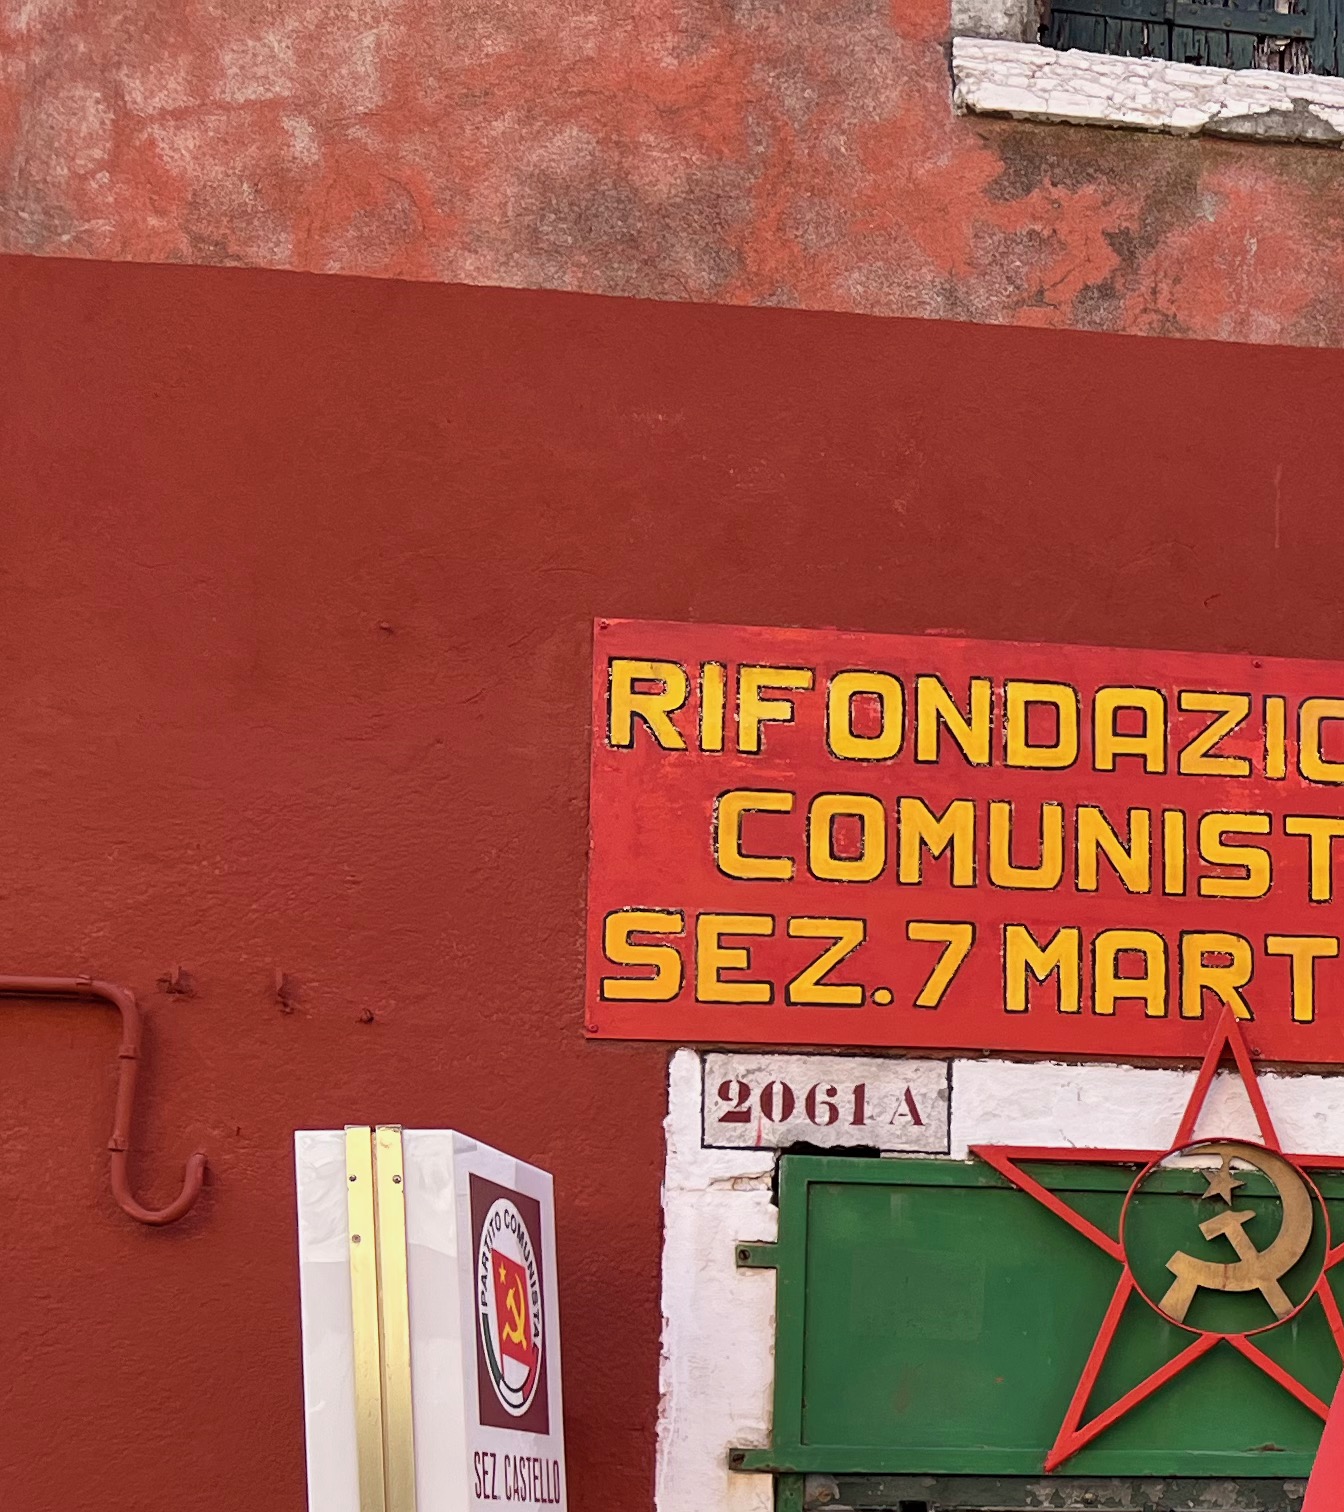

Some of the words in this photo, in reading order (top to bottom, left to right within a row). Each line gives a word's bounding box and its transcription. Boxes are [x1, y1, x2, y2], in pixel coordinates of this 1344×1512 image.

[717, 1079, 866, 1127] 2061
[481, 1211, 502, 1307] PARTITO
[503, 1208, 541, 1338] COMUNISTA
[504, 1454, 560, 1503] CASTELLO
